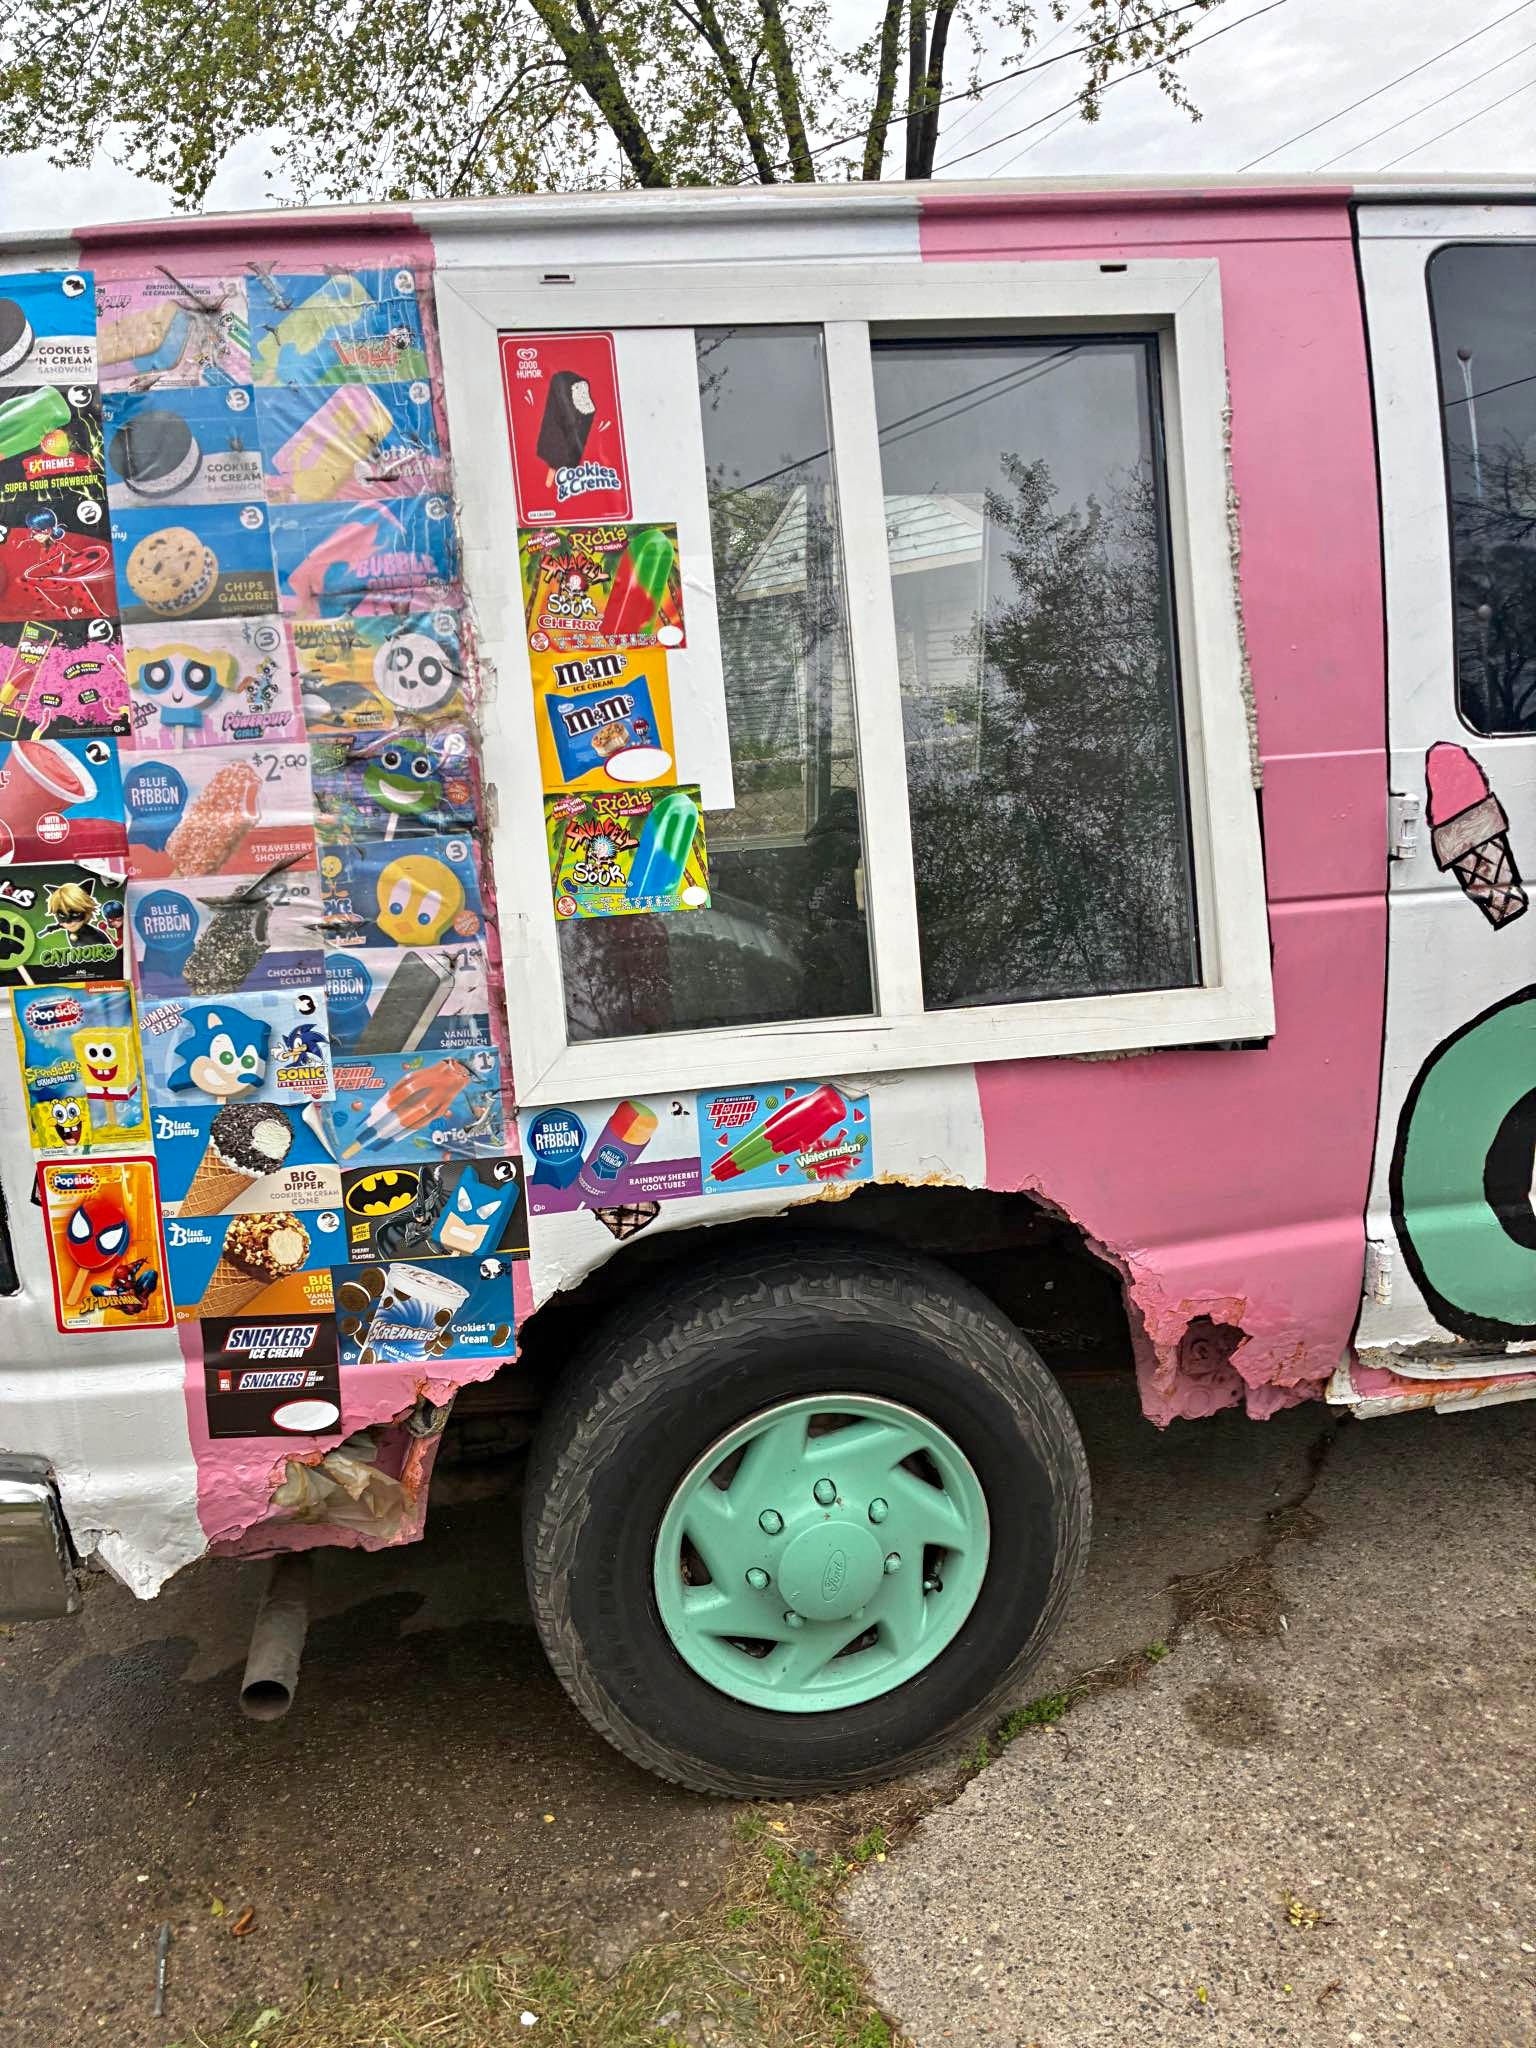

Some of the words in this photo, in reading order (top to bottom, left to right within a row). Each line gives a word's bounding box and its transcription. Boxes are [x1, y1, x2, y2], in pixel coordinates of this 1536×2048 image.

[39, 346, 90, 355] COOKIES
[52, 356, 92, 365] CREAM
[518, 361, 538, 369] GOOD
[38, 364, 91, 374] SANDWICH
[516, 369, 542, 379] HUMOR
[29, 457, 75, 473] EXTREMES
[207, 462, 258, 473] COOKIES
[221, 471, 261, 482] CREAM
[556, 462, 616, 485] Cookies
[4, 481, 28, 493] SUPER
[30, 479, 49, 490] SOUR
[51, 474, 98, 488] STRAWBERRY
[558, 484, 570, 501] &
[570, 476, 620, 495] Creme
[569, 527, 627, 553] Rich's
[540, 551, 610, 583] SAVAGELY
[224, 580, 265, 591] CHIPS
[218, 590, 274, 602] GALORE!
[547, 593, 597, 619] SOUR
[538, 615, 602, 632] CHERRY
[20, 641, 48, 655] Trolli
[555, 654, 627, 686] m&m's
[573, 685, 585, 693] ICE
[587, 679, 614, 690] CREAM
[222, 711, 291, 731] POWERPUFF
[564, 695, 634, 735] m&m's
[234, 728, 262, 739] GIRLS
[139, 776, 168, 787] BLUE
[131, 787, 180, 806] RIBBON
[597, 791, 652, 818] Rich's
[44, 832, 62, 840] INSIDE
[566, 817, 639, 851] SAVAGELY
[251, 842, 314, 854] STRAWBERRY
[573, 862, 625, 886] SOUR
[151, 906, 180, 916] BLUE
[144, 915, 191, 935] RIBBON
[40, 949, 69, 967] CAT
[69, 945, 107, 963] NOIR
[267, 967, 322, 978] CHOCOLATE
[325, 968, 353, 979] BLUE
[280, 976, 313, 985] ECLAIR
[325, 978, 364, 996] IBBON
[297, 994, 317, 1015] 3
[31, 1002, 79, 1022] Popsicle
[139, 1003, 185, 1030] GUMBALL
[151, 1014, 183, 1036] EYES!
[444, 1029, 483, 1039] VANILA
[440, 1037, 488, 1048] SANDWICH
[277, 1066, 326, 1081] SONIC
[706, 1101, 759, 1117] BOMB
[542, 1121, 569, 1132] BLUE
[714, 1113, 751, 1129] POP
[535, 1130, 580, 1151] RIBBON
[600, 1151, 623, 1168] RIBBON
[796, 1143, 861, 1167] Watermelon
[54, 1174, 96, 1188] Popsicle
[290, 1170, 317, 1183] BIG
[629, 1174, 667, 1186] RAINBOW
[667, 1171, 700, 1181] SHERBET
[284, 1181, 323, 1191] DIPPER
[641, 1183, 663, 1192] COOL
[663, 1181, 687, 1190] TUBES
[308, 1275, 333, 1286] BIG
[303, 1285, 333, 1294] DIPPE
[306, 1292, 334, 1300] VANILL
[79, 1295, 143, 1314] SPIDER-MAN
[310, 1298, 335, 1306] CON
[369, 1320, 440, 1342] SCREAMERS
[451, 1322, 486, 1333] Cookies
[486, 1322, 496, 1331] 'n
[228, 1326, 315, 1349] SNICKERS
[459, 1333, 489, 1345] Cream
[248, 1349, 266, 1359] ICE
[267, 1348, 305, 1359] CREAM
[242, 1372, 304, 1388] SNICKERS
